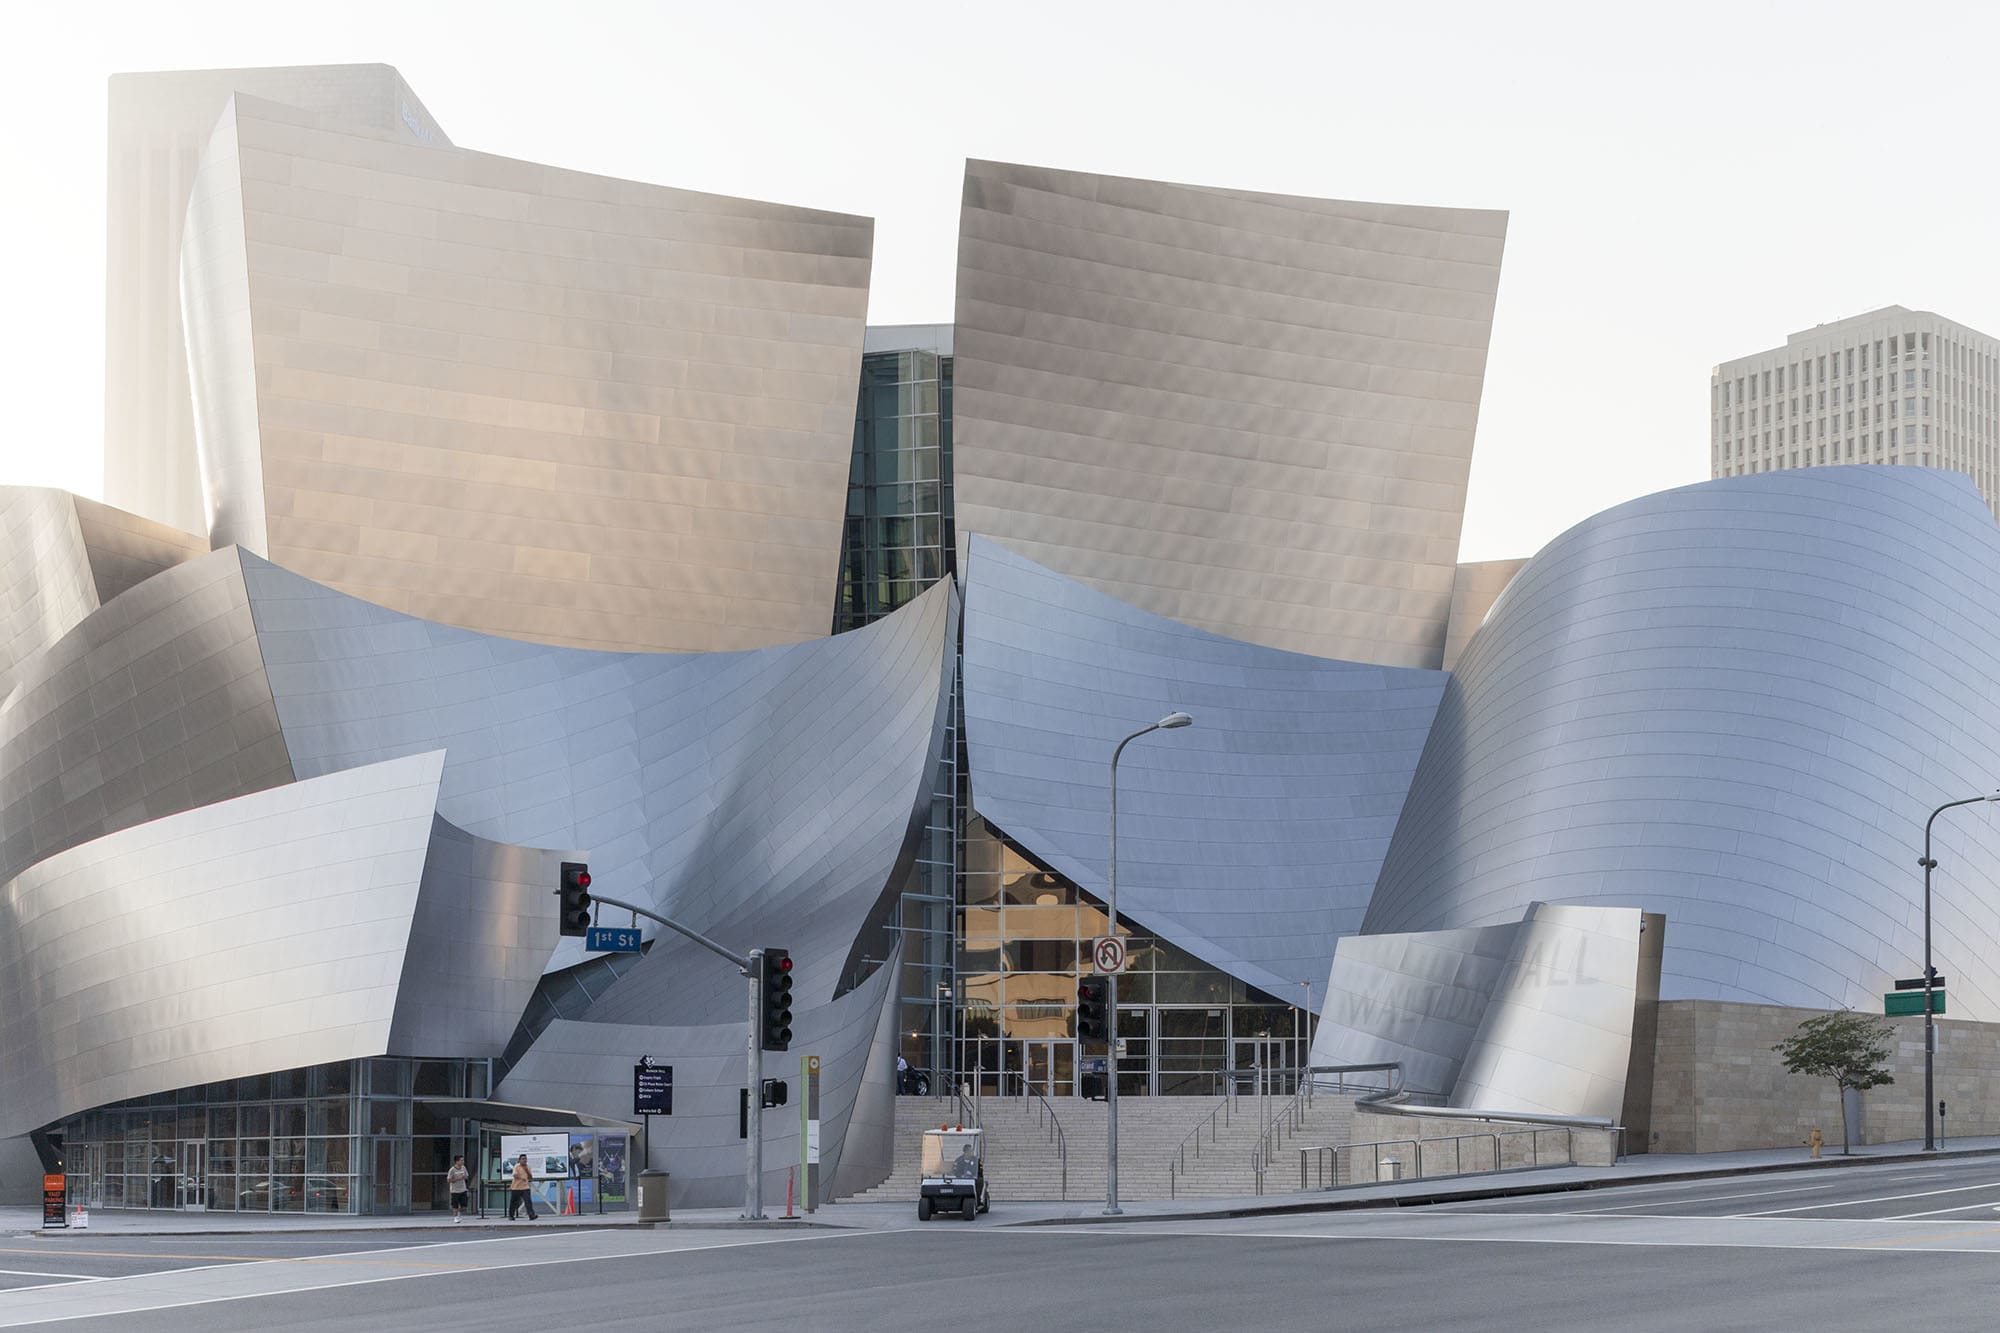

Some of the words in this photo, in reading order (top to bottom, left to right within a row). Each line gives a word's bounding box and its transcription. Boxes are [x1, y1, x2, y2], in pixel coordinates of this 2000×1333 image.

[595, 932, 612, 948] 1st
[618, 934, 634, 947] St
[1346, 983, 1442, 1024] WALT
